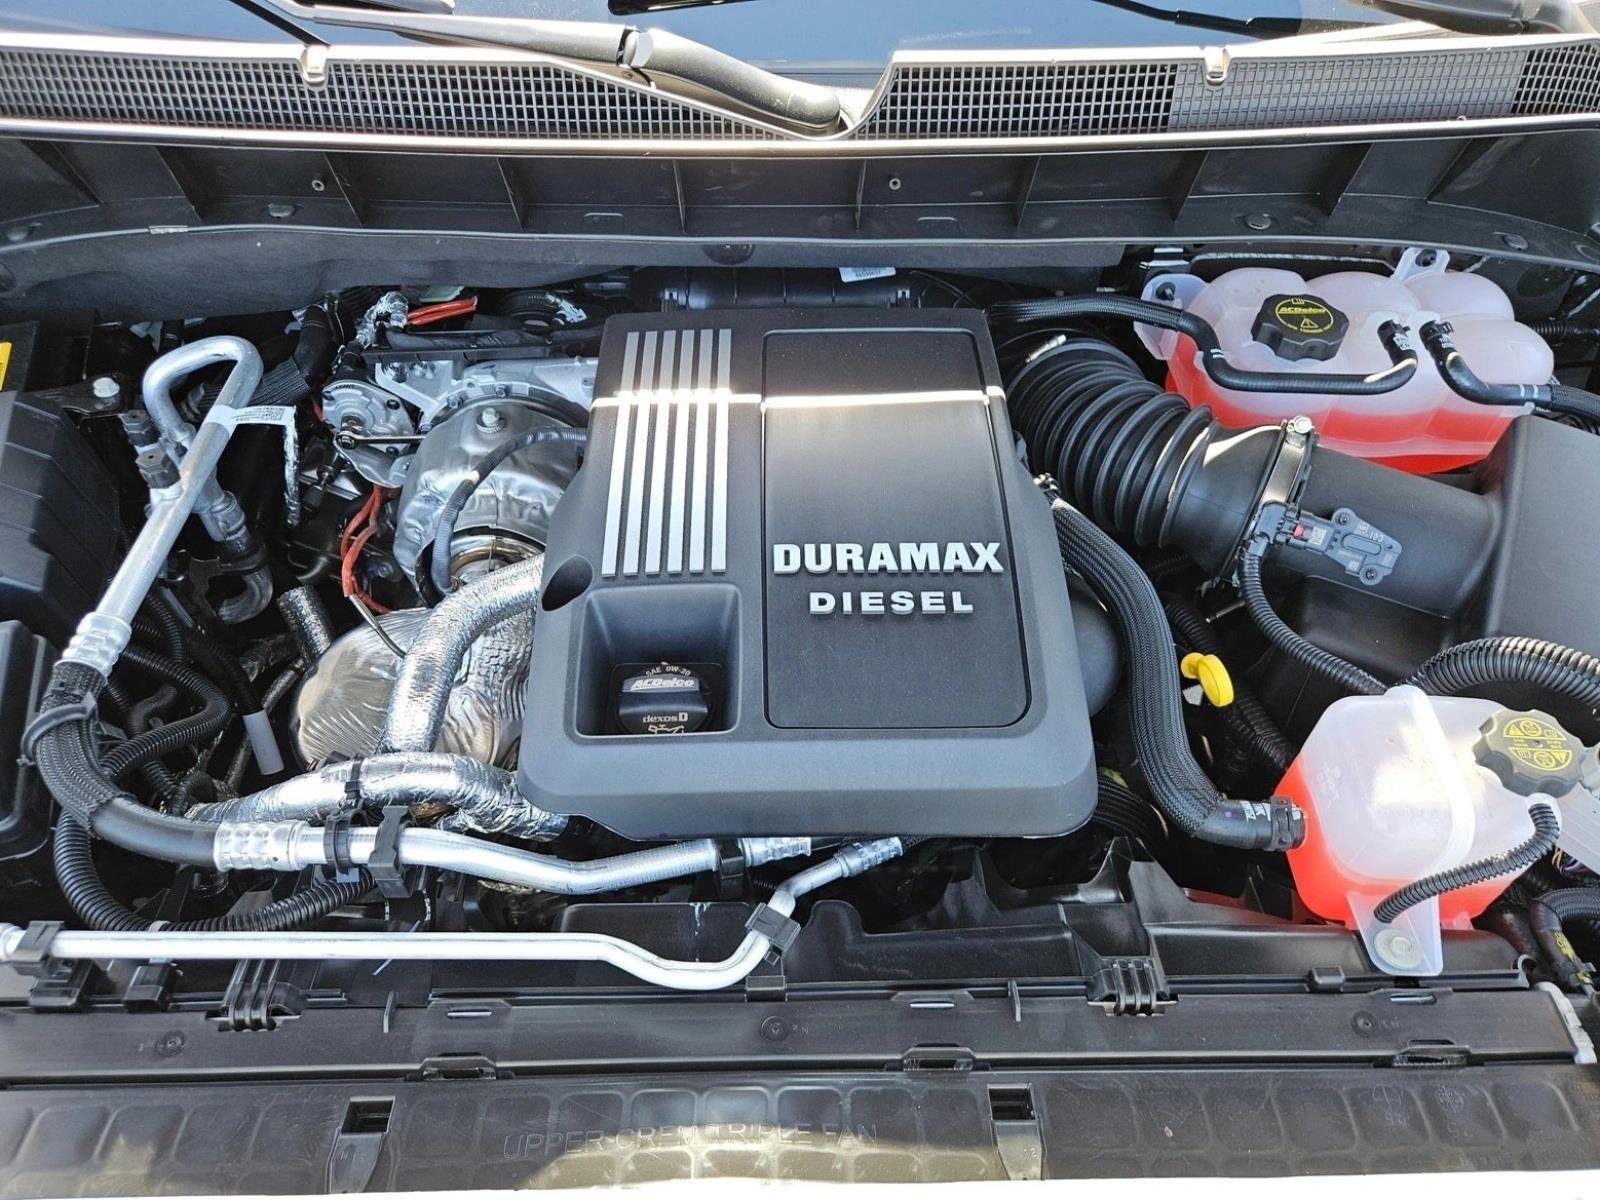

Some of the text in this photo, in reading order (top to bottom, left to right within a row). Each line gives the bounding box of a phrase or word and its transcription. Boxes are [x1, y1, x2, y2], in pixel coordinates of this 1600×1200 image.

[773, 542, 1004, 574] DURAMAX
[809, 591, 974, 615] DIESEL
[645, 666, 662, 678] SAE
[630, 678, 695, 691] ACDelco
[503, 1130, 605, 1160] UPPER
